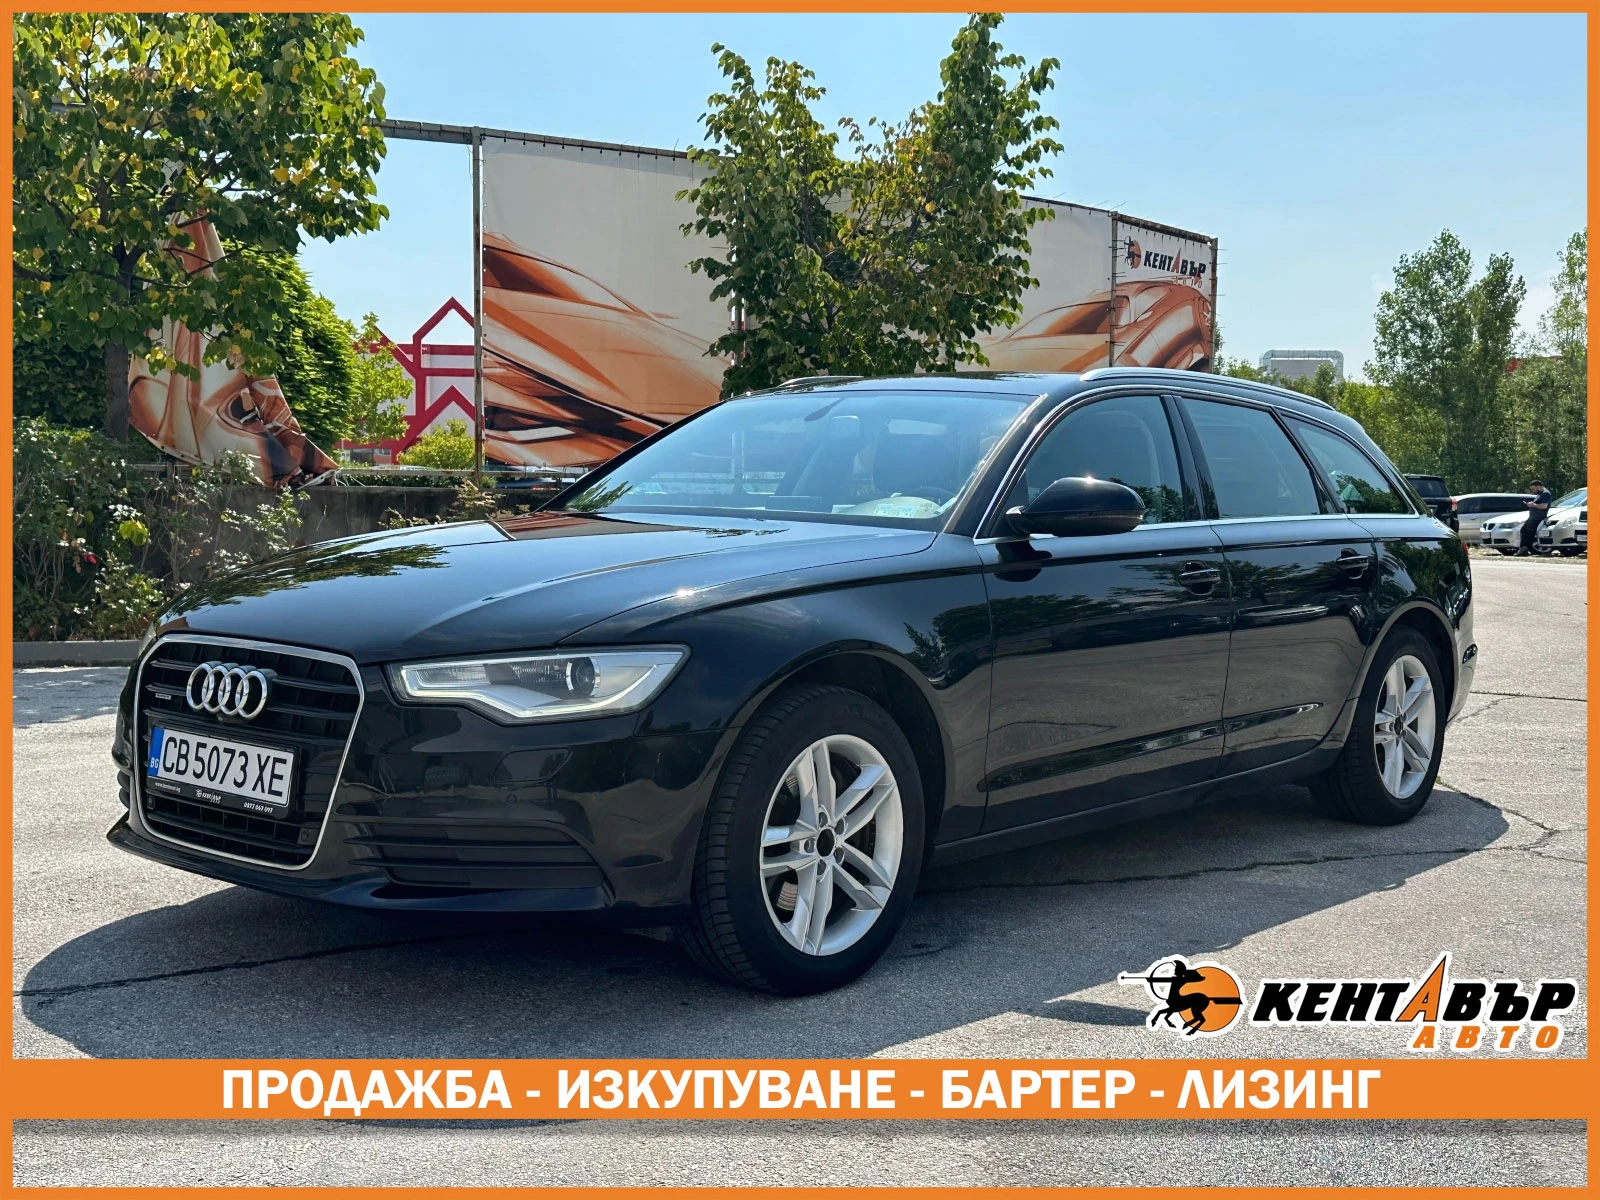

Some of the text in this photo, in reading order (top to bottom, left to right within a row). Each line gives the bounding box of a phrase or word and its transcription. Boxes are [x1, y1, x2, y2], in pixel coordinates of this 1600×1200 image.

[1143, 248, 1207, 278] КЕНТАВЪР
[149, 757, 160, 769] BG
[162, 736, 287, 797] CB 5073 XE
